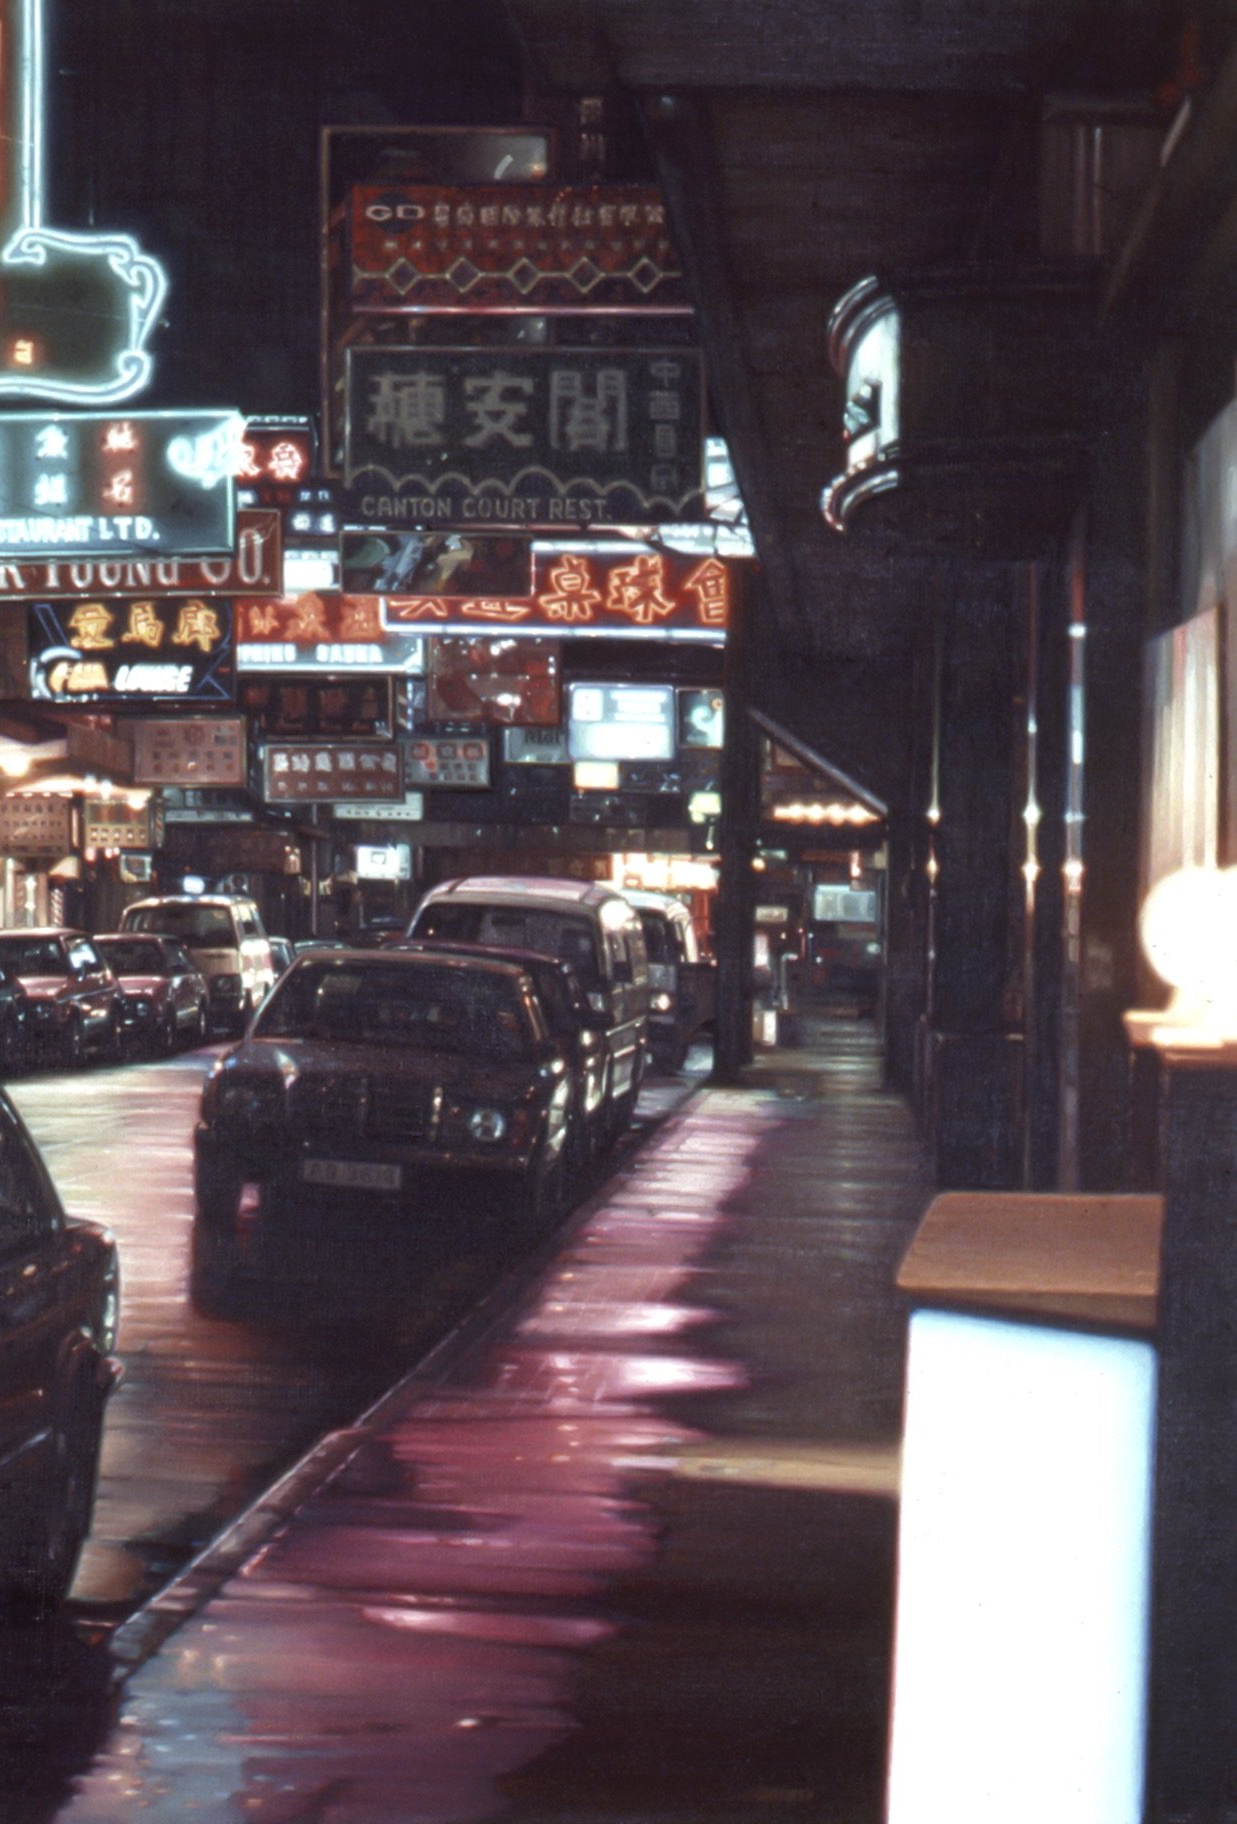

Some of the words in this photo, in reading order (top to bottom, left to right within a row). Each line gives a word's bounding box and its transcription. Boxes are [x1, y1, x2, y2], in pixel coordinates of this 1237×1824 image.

[361, 495, 452, 518] CANTON
[462, 497, 540, 519] COURT
[548, 498, 614, 520] REST.
[99, 517, 161, 541] LTD.
